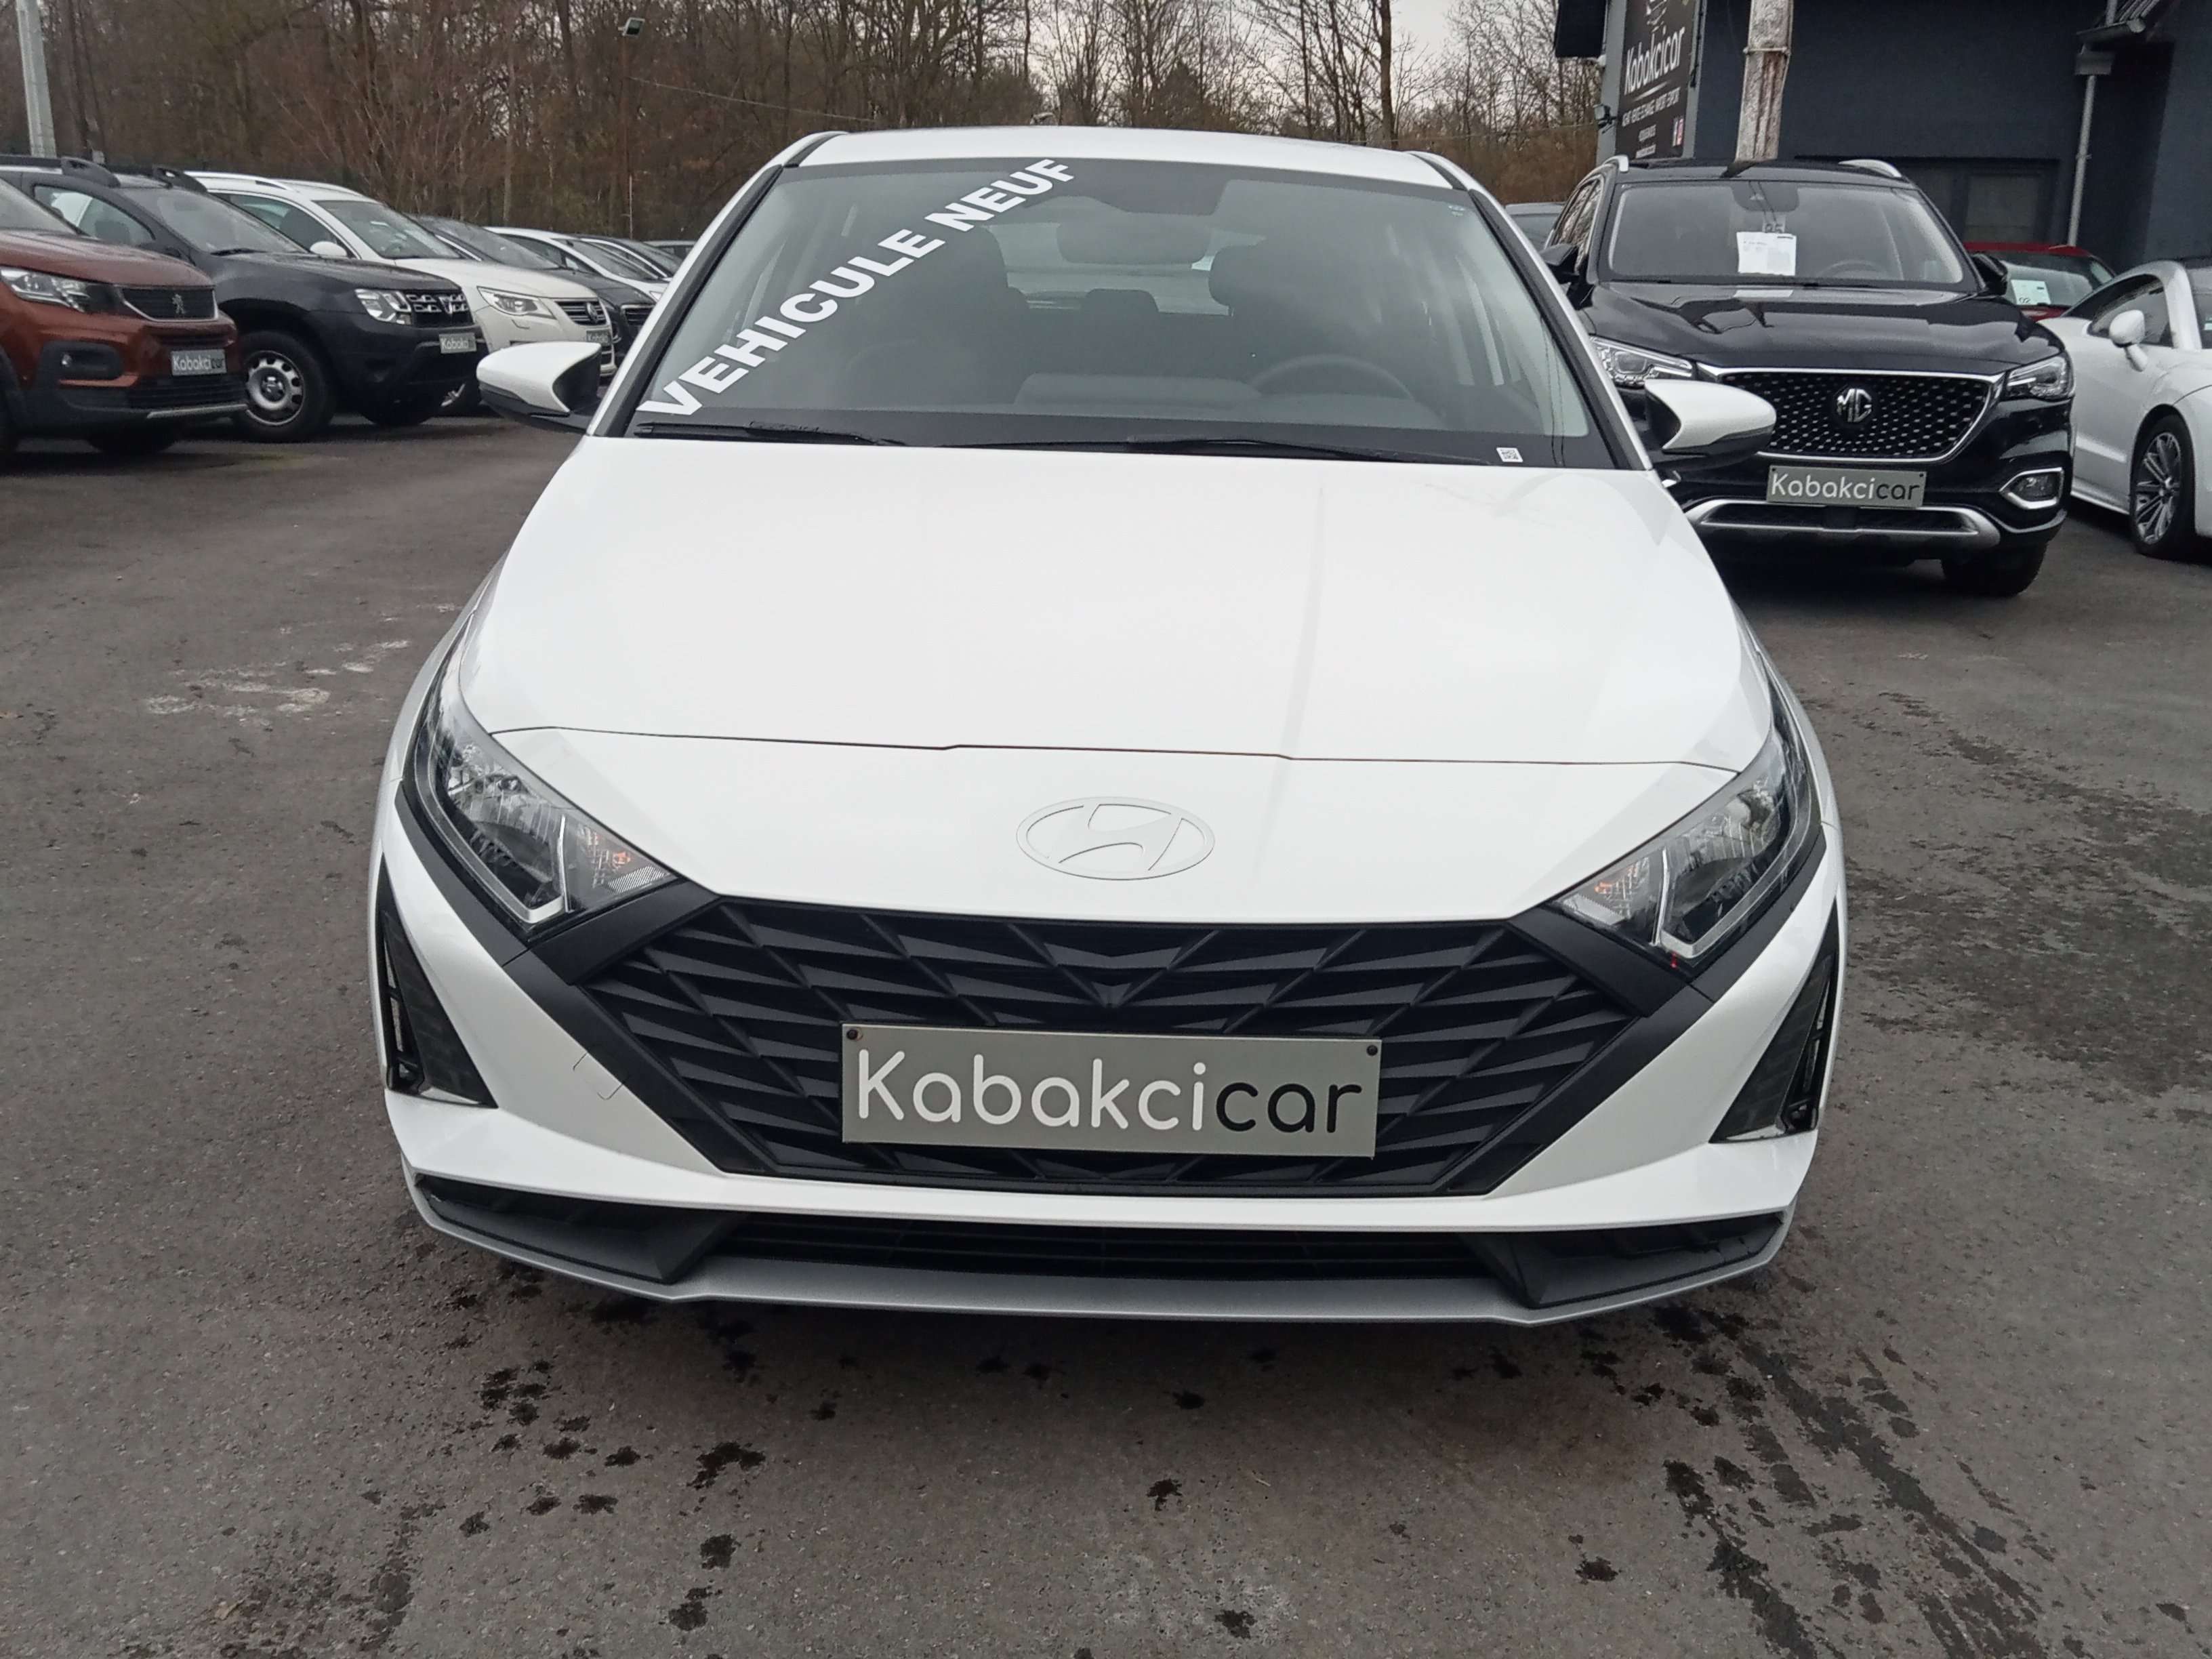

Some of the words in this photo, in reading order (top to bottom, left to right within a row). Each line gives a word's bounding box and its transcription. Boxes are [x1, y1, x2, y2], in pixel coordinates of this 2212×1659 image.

[1624, 26, 1686, 96] Kabakcicar
[636, 228, 945, 415] VEHICULE
[924, 159, 1074, 232] NEUF
[1836, 388, 1872, 423] MG
[1771, 473, 1921, 500] Kabakcicar
[858, 1048, 1362, 1133] Kabakcicar
